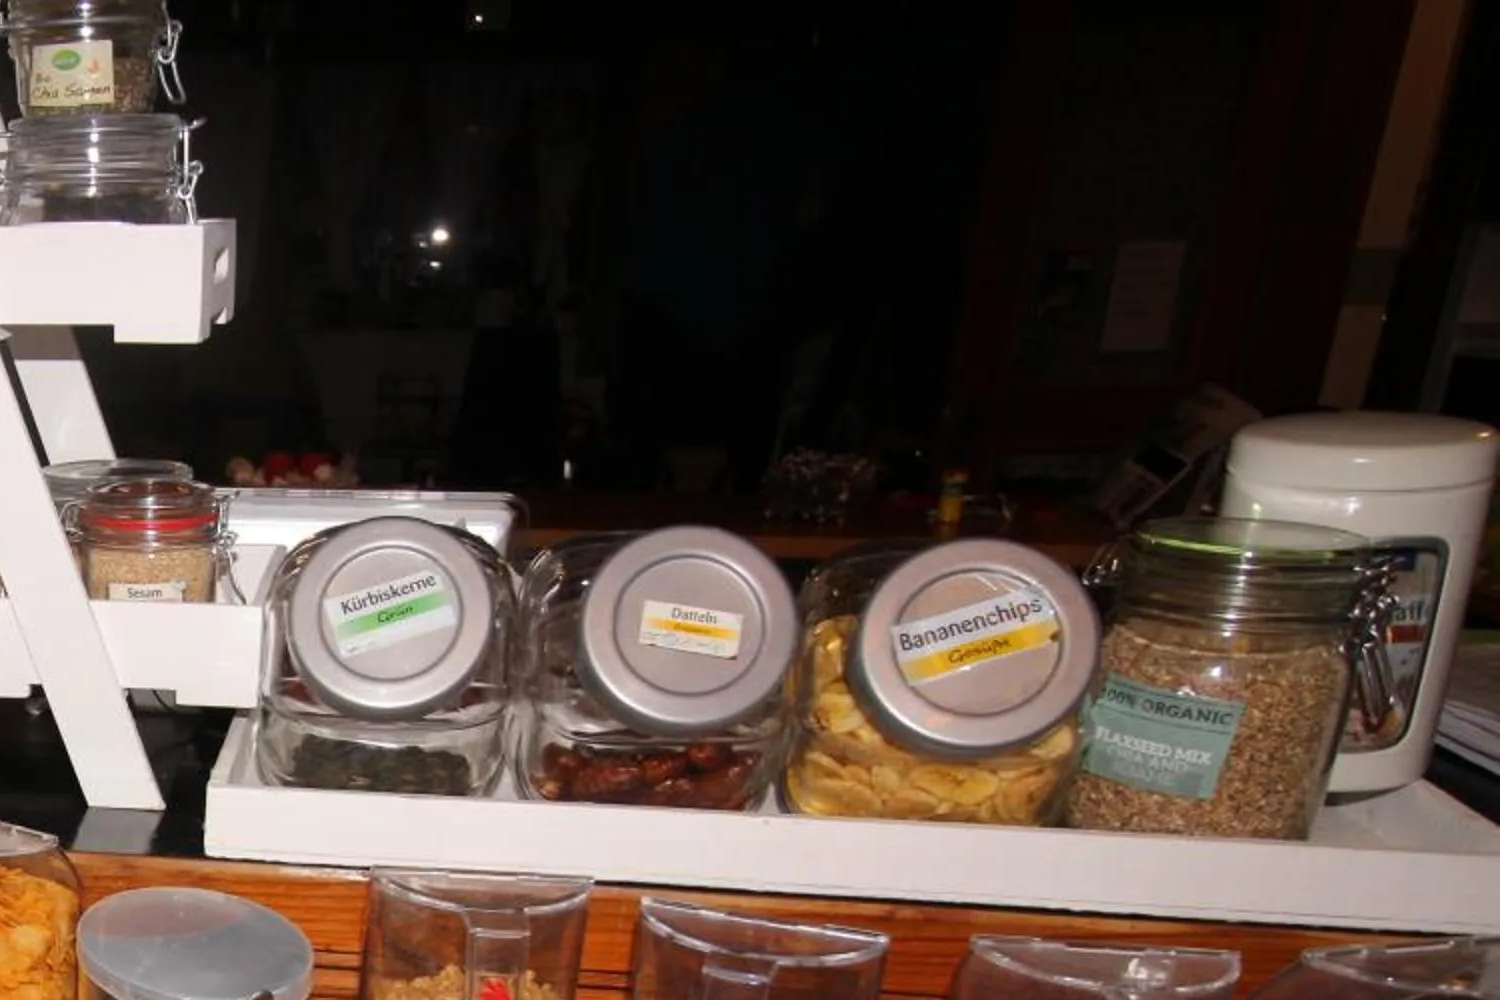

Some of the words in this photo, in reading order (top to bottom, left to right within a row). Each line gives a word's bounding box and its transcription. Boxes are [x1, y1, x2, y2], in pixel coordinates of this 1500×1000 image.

[340, 575, 438, 616] Kürbiskerne
[899, 598, 1043, 651] Bananenchips
[1141, 698, 1233, 726] ORGANIC
[1174, 746, 1213, 766] MIX
